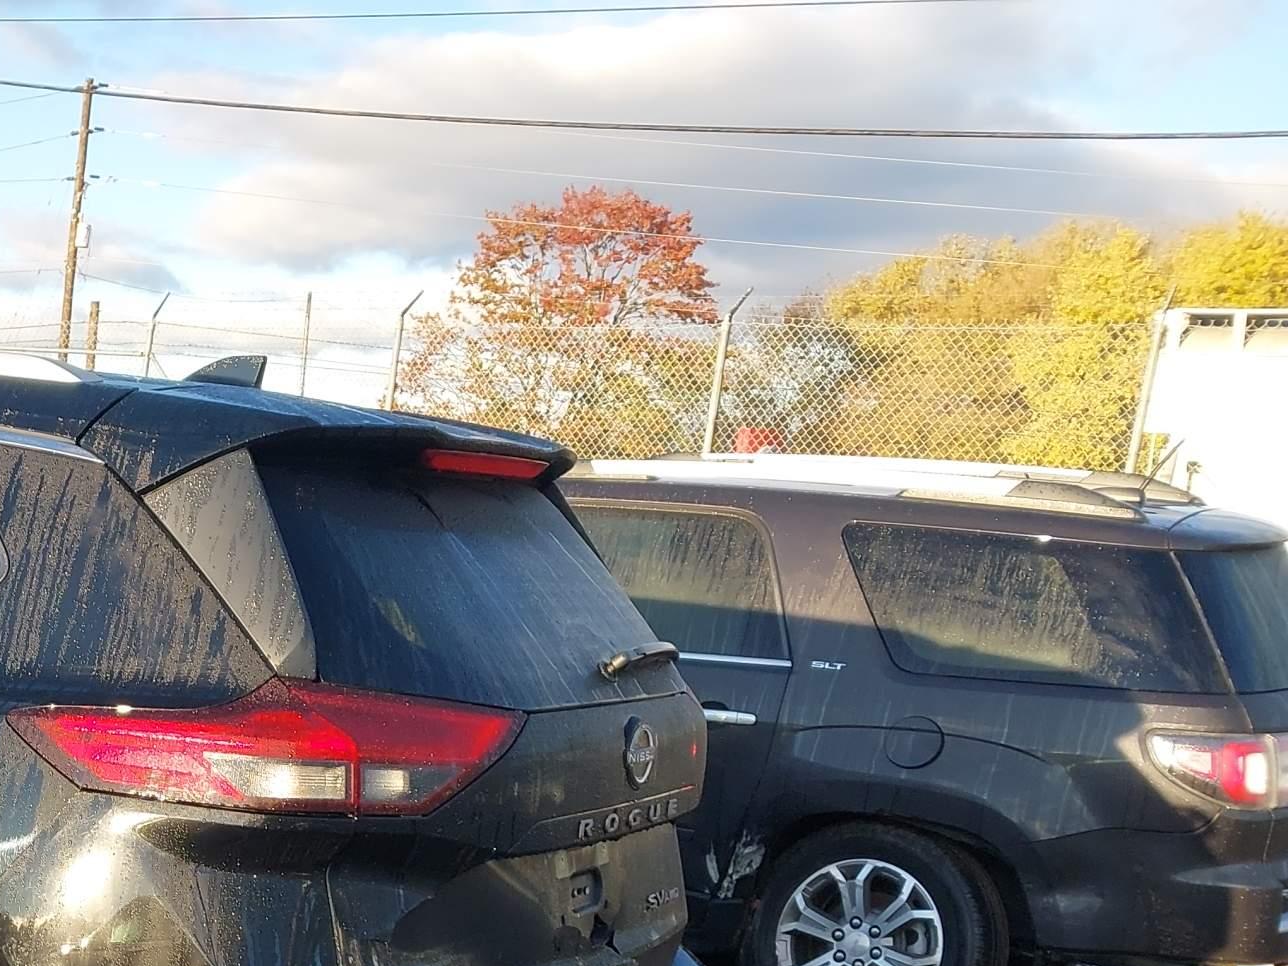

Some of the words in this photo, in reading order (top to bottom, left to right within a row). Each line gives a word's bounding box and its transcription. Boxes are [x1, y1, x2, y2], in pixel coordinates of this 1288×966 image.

[811, 660, 847, 670] SLT
[578, 798, 679, 840] ROGUE
[647, 889, 665, 908] SV
